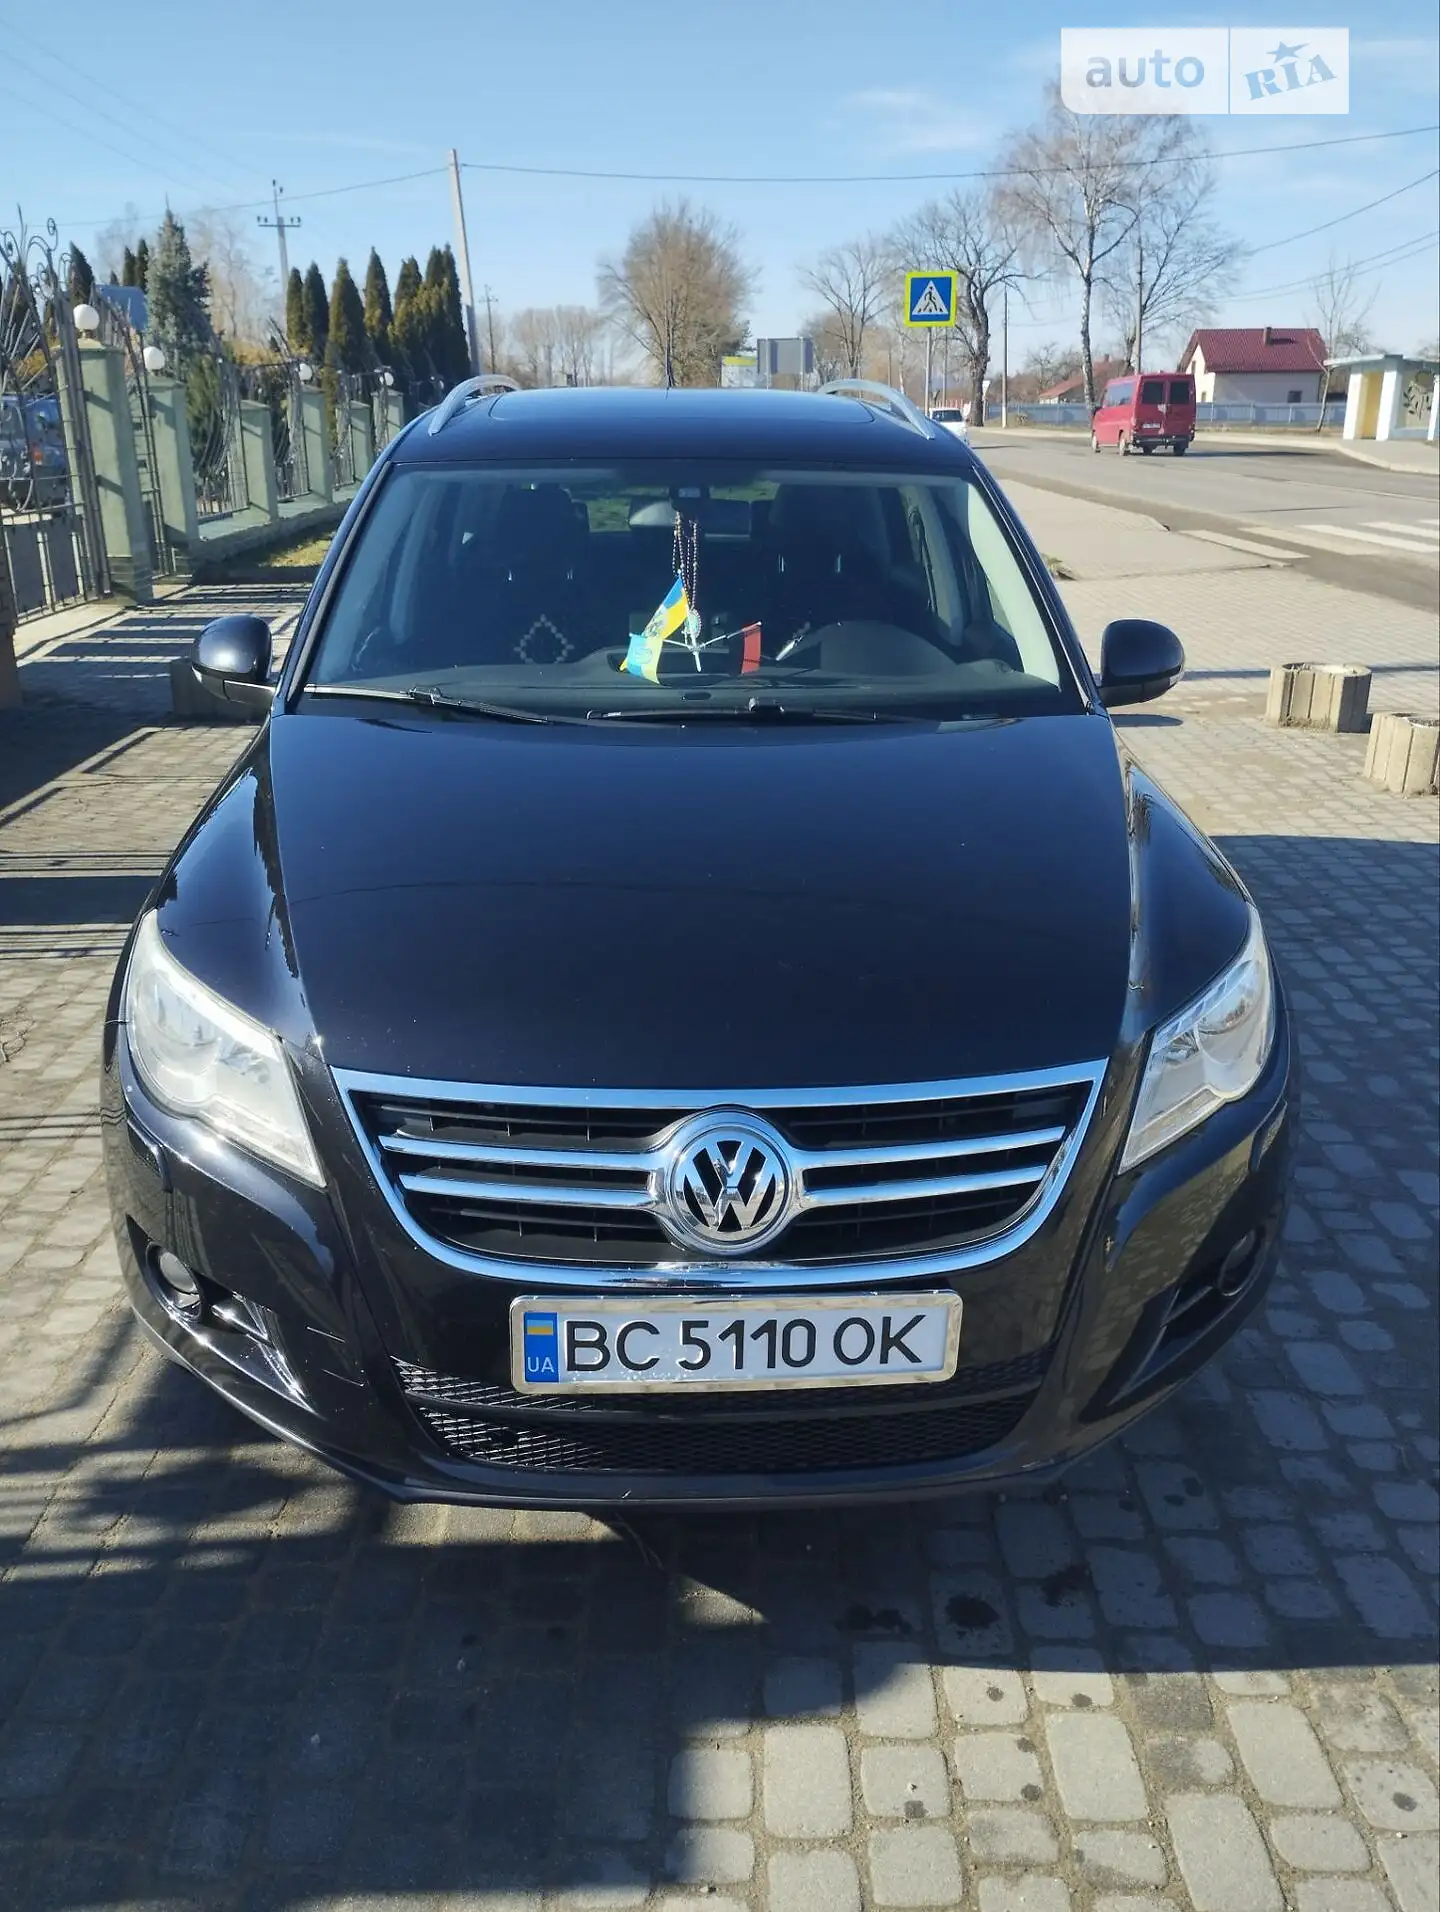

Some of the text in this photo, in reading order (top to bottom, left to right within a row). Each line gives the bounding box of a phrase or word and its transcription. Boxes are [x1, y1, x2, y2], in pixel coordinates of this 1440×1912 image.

[565, 1314, 927, 1372] BC 5110 OK
[527, 1355, 555, 1373] UA
